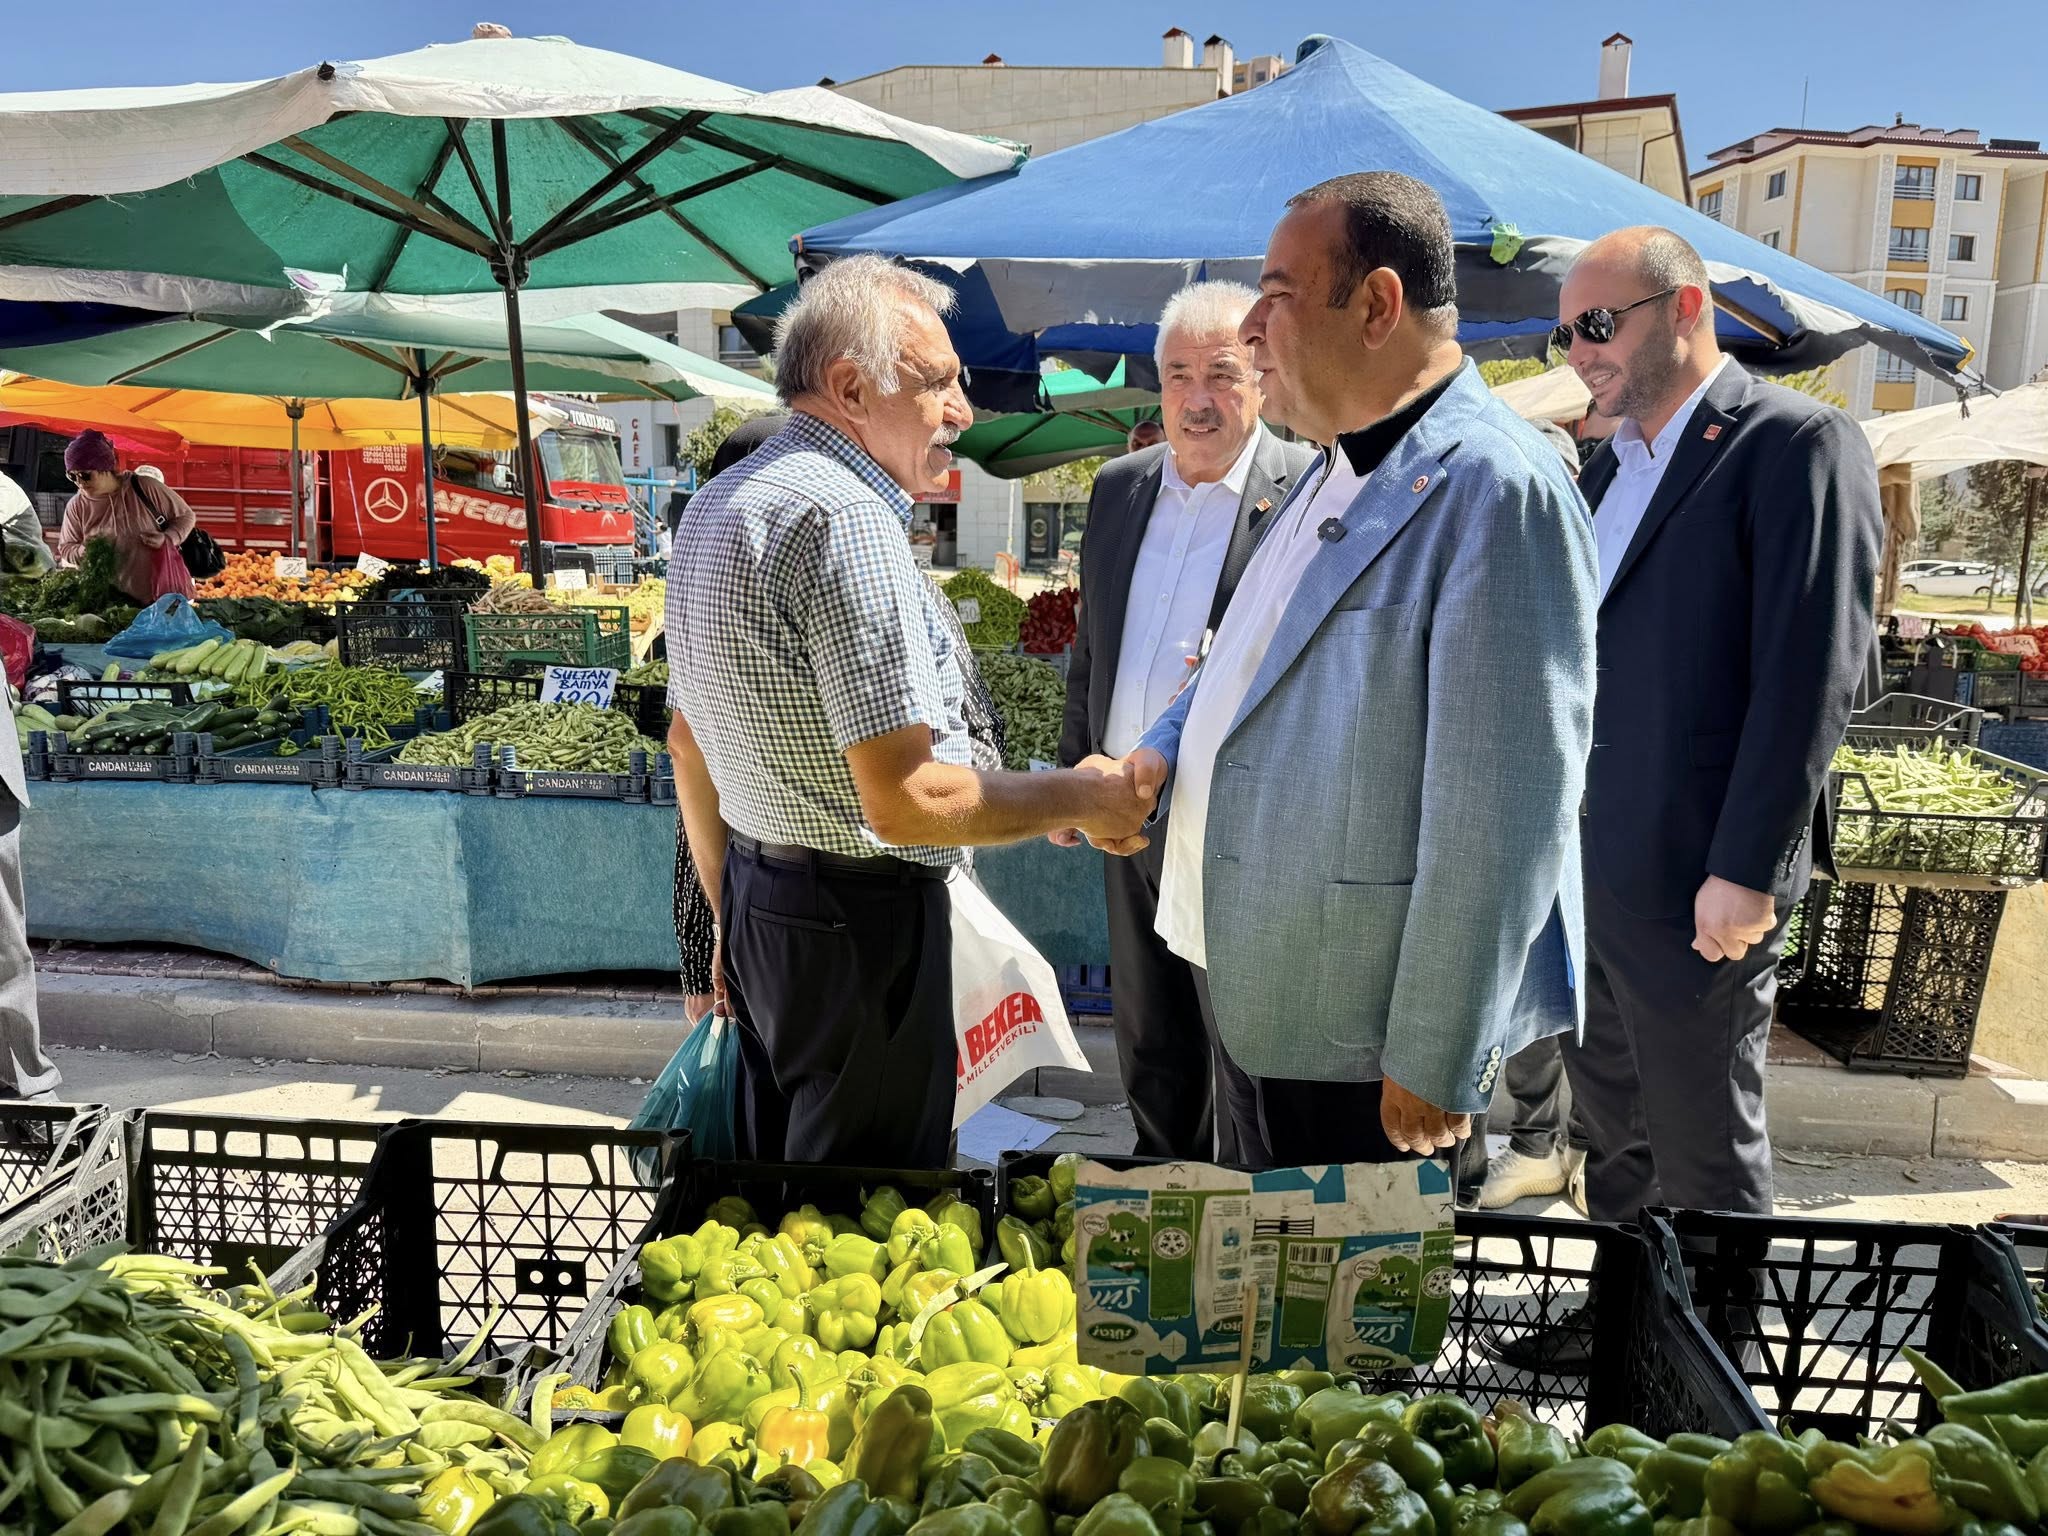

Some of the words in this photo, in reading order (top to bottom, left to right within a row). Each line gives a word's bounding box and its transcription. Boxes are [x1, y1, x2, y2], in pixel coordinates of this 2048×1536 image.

[631, 418, 640, 467] CAFE
[550, 668, 611, 680] SULTAN
[558, 679, 608, 690] BAMYA
[88, 761, 128, 772] CANDAN
[234, 764, 274, 775] CANDAN
[383, 770, 425, 782] CANDAN
[537, 778, 580, 789] CANDAN
[964, 991, 1044, 1068] BEKER
[966, 1022, 1037, 1085] MİLLETVEKİLİ
